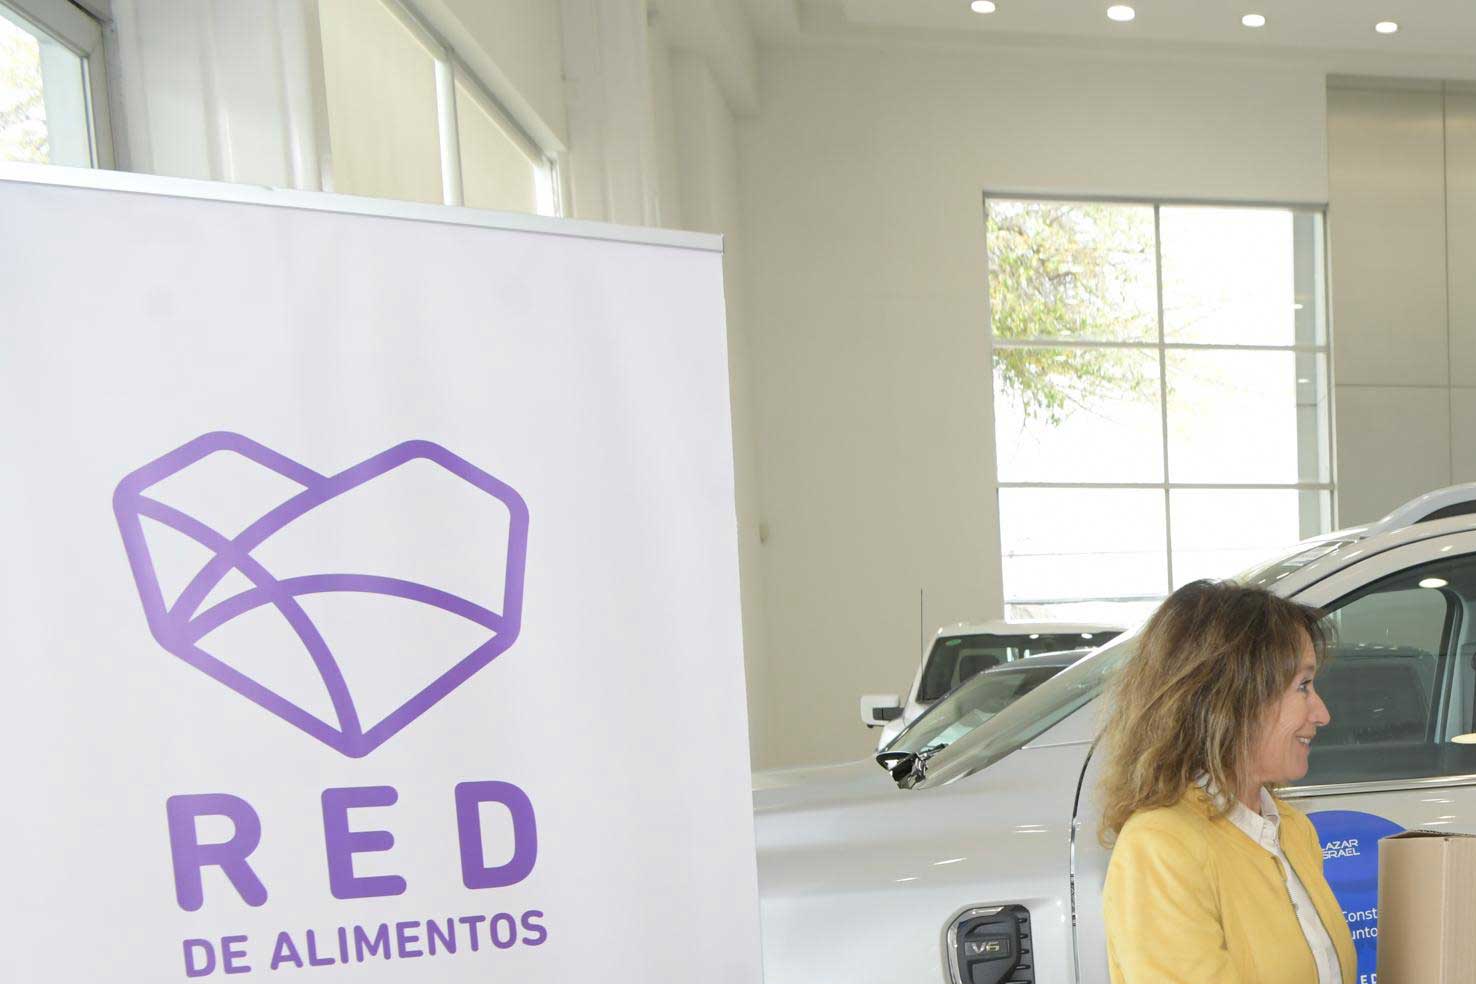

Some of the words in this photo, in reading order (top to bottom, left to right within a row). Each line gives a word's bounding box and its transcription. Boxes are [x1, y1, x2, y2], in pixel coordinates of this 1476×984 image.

[166, 780, 538, 912] RED
[1323, 839, 1358, 850] AZAR
[1323, 848, 1360, 859] SRAEL
[182, 934, 252, 978] DE
[270, 909, 548, 971] ALIMENTOS
